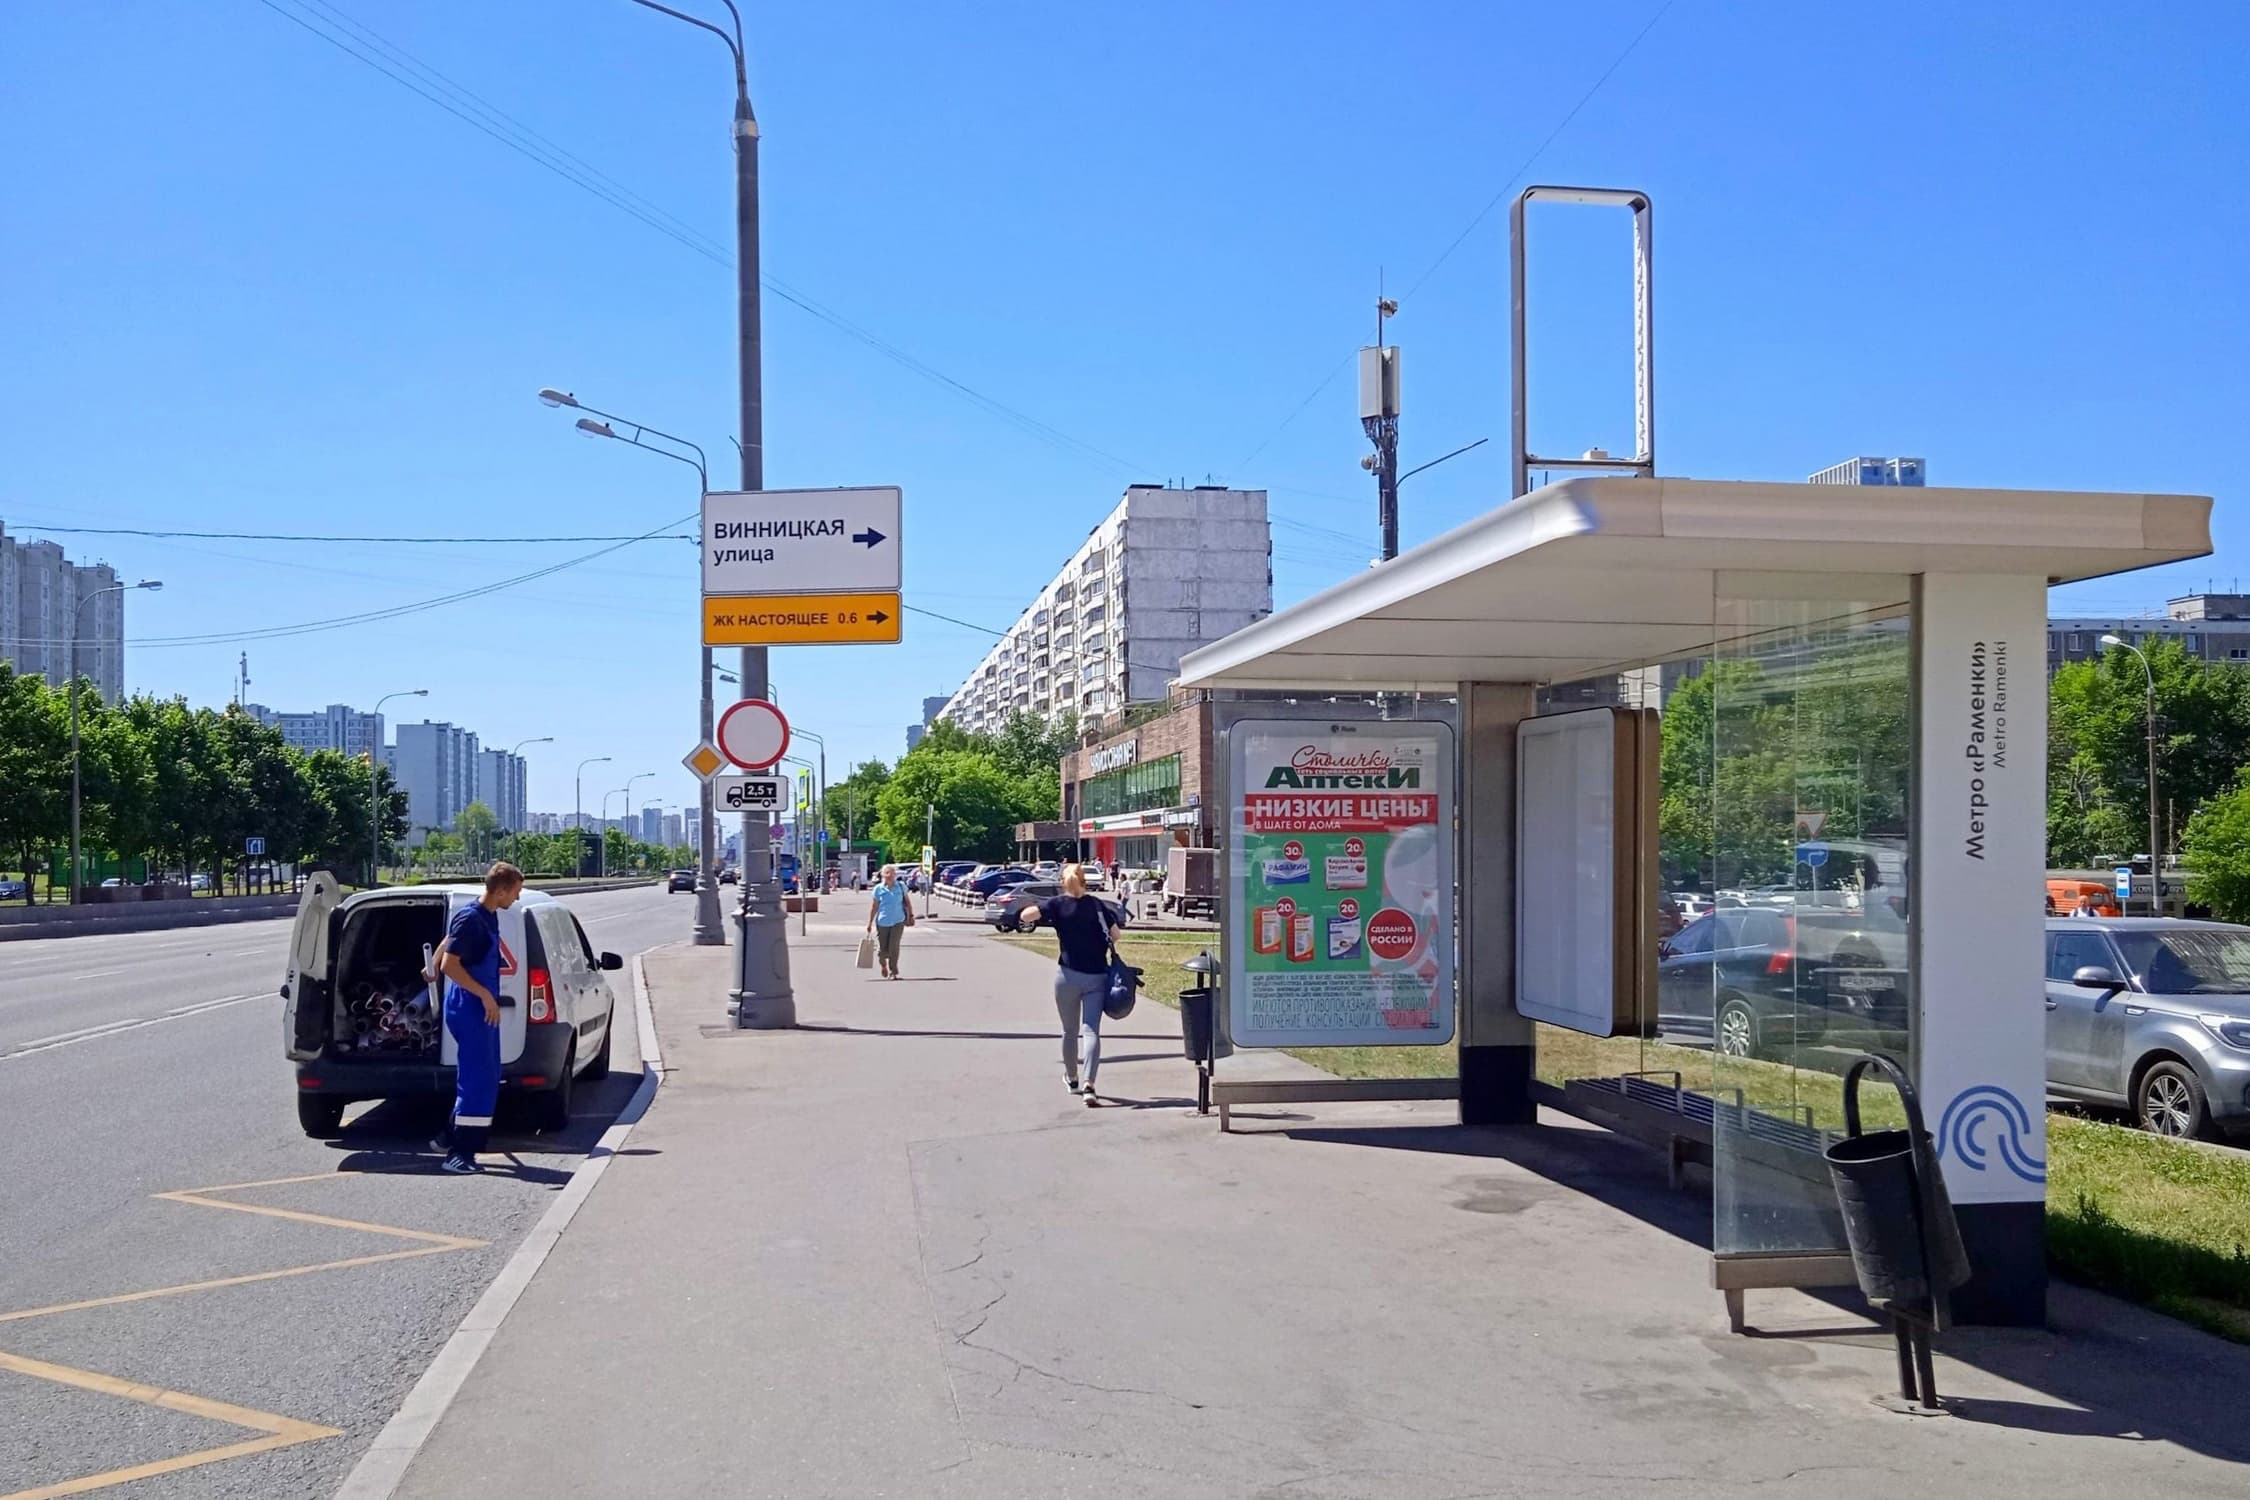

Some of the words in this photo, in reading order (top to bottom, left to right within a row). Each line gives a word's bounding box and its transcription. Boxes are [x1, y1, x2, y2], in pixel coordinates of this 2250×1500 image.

[714, 519, 845, 539] ВИННИЦКАЯ
[713, 548, 774, 566] улица
[713, 615, 735, 626] ЖК
[738, 613, 829, 626] НАСТОЯЩЕЕ
[838, 612, 858, 624] 0.6
[1992, 641, 2007, 712] Ramenki
[1966, 641, 1986, 772] «Раменки»
[1992, 717, 2006, 768] Metro
[1291, 745, 1394, 768] Столички
[747, 785, 765, 796] 2,5
[1255, 800, 1353, 818] НИЗКИЕ
[1361, 799, 1428, 820] ЦЕНЫ
[1966, 778, 1989, 860] Метро
[1255, 822, 1261, 830] В
[1264, 821, 1291, 830] ШАГЕ
[1294, 821, 1306, 830] ОТ
[1308, 821, 1341, 830] ДОМА
[1371, 935, 1413, 944] РОССИИ
